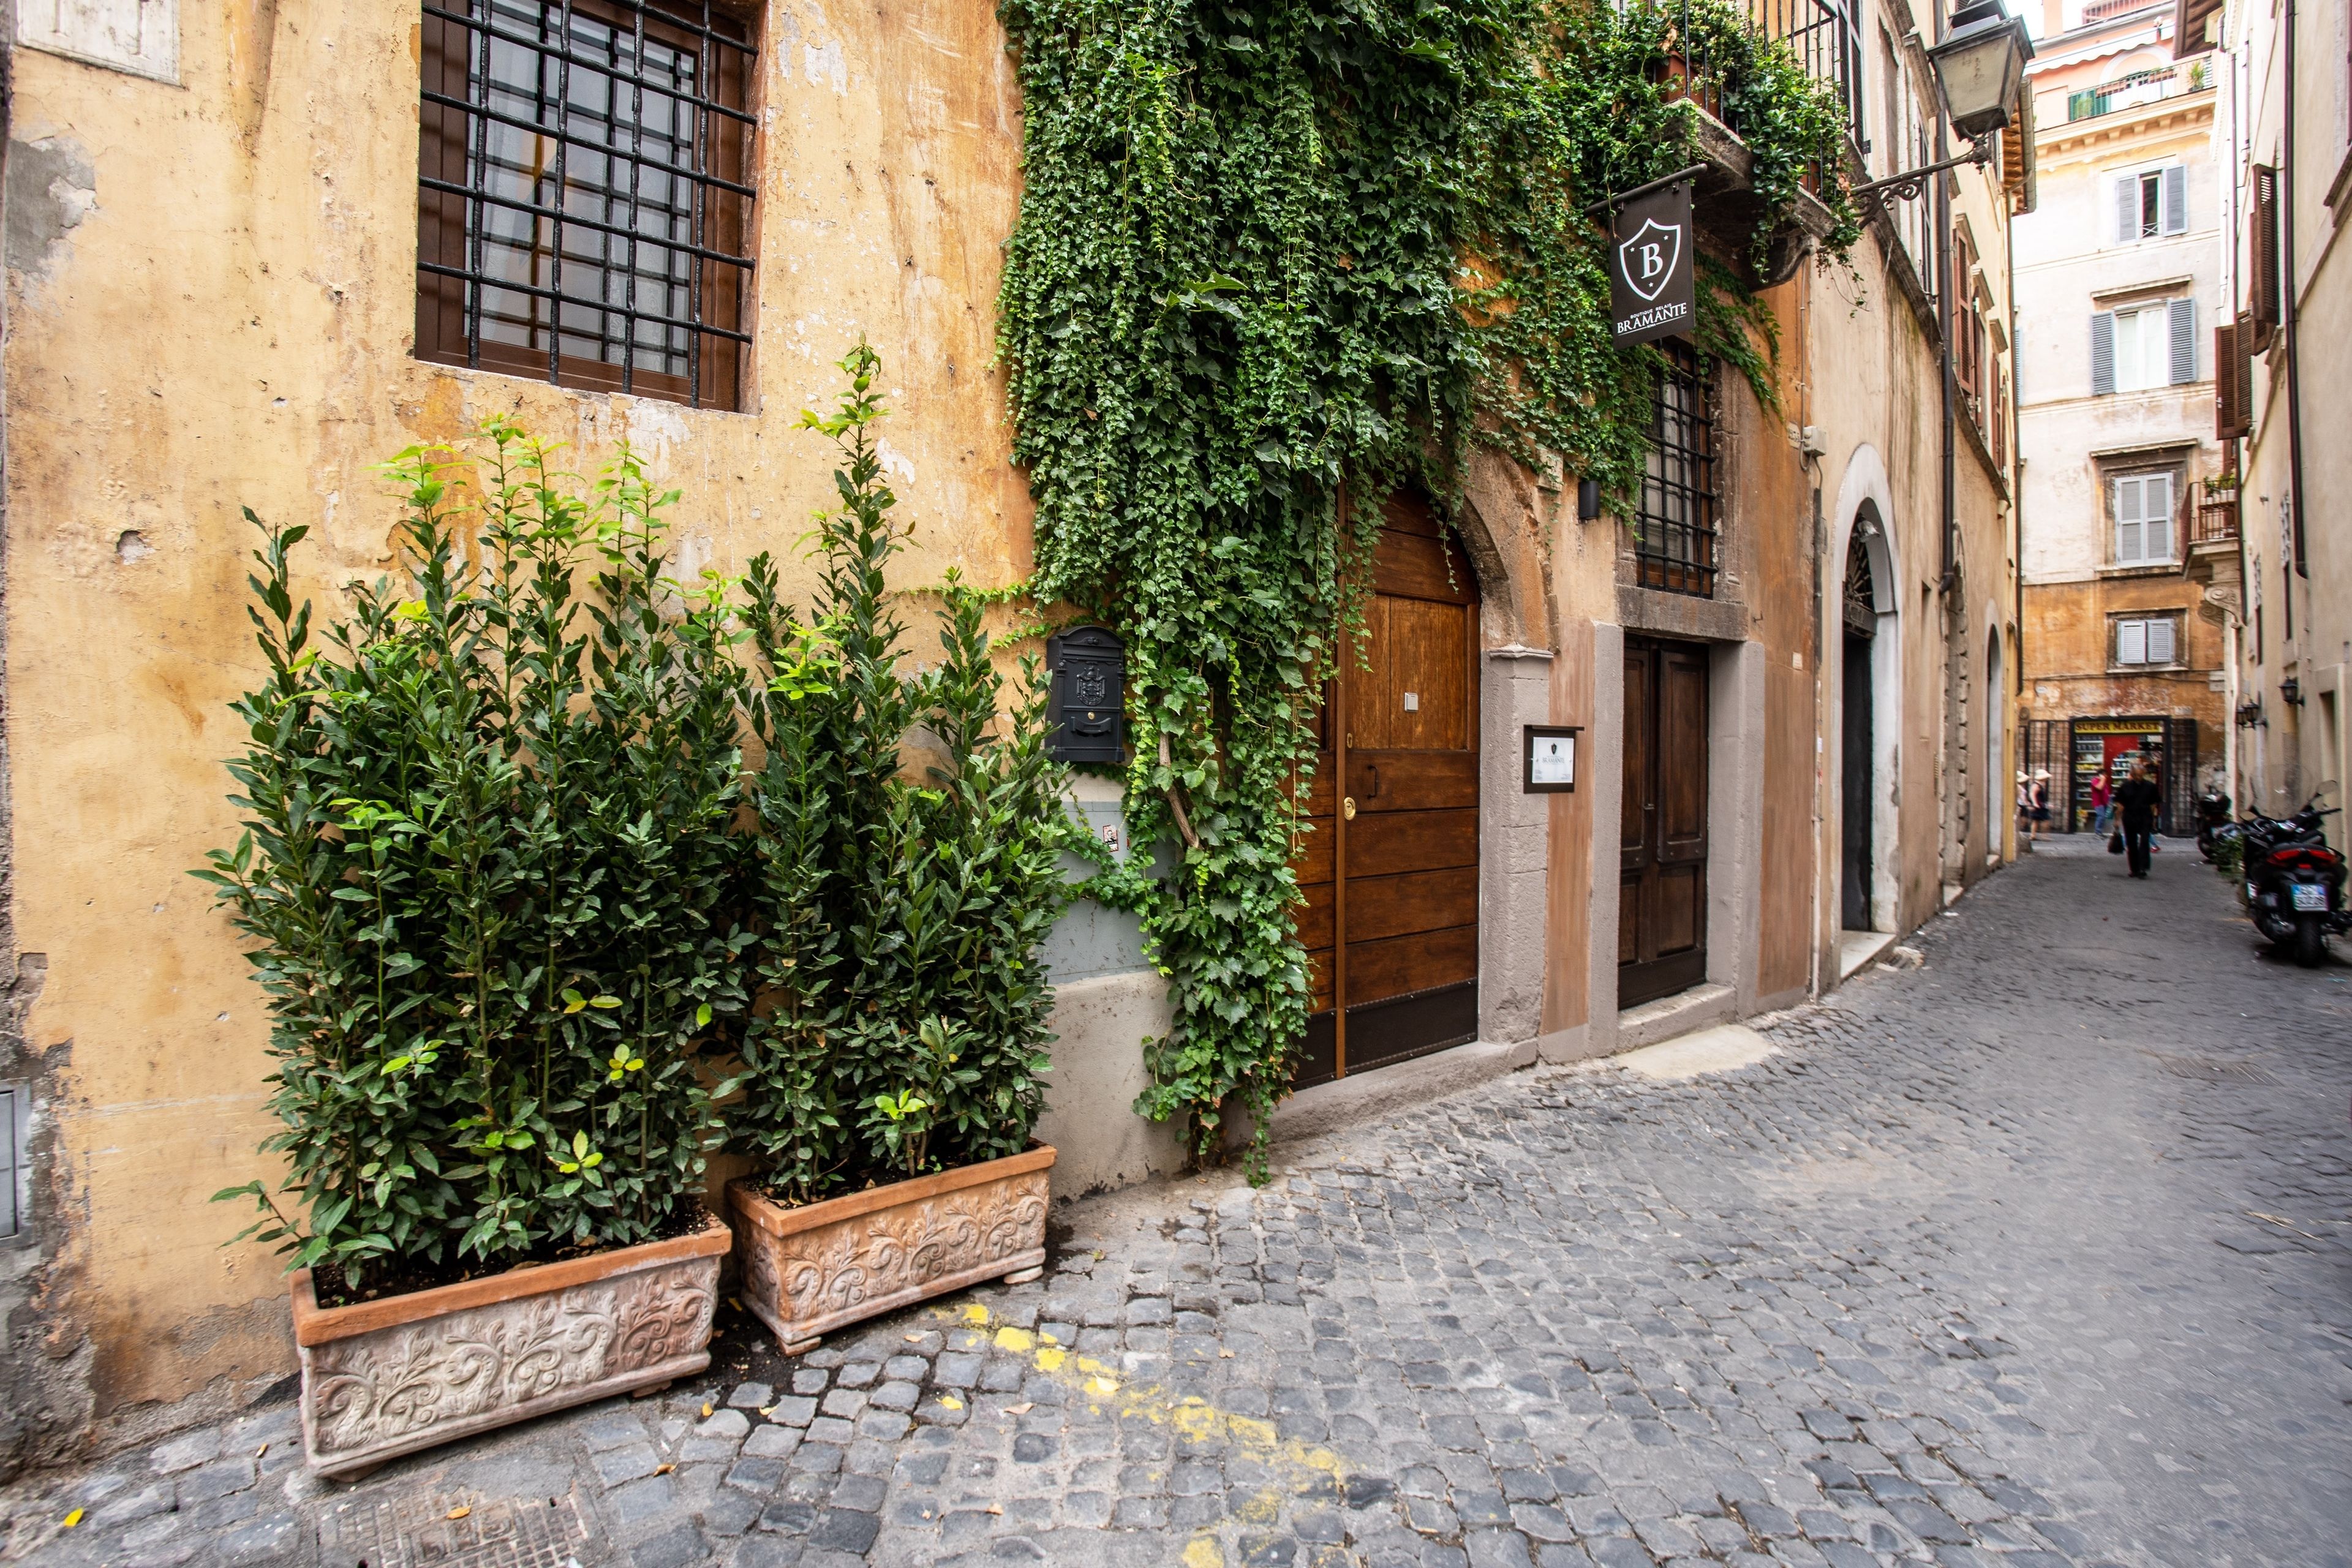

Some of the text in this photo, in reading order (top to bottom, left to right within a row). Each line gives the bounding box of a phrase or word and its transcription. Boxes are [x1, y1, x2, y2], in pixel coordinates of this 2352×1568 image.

[1640, 243, 1663, 279] B
[1617, 303, 1687, 333] BRAMANTE
[1630, 309, 1653, 319] BOUTIQUE
[2113, 722, 2159, 731] MARKET
